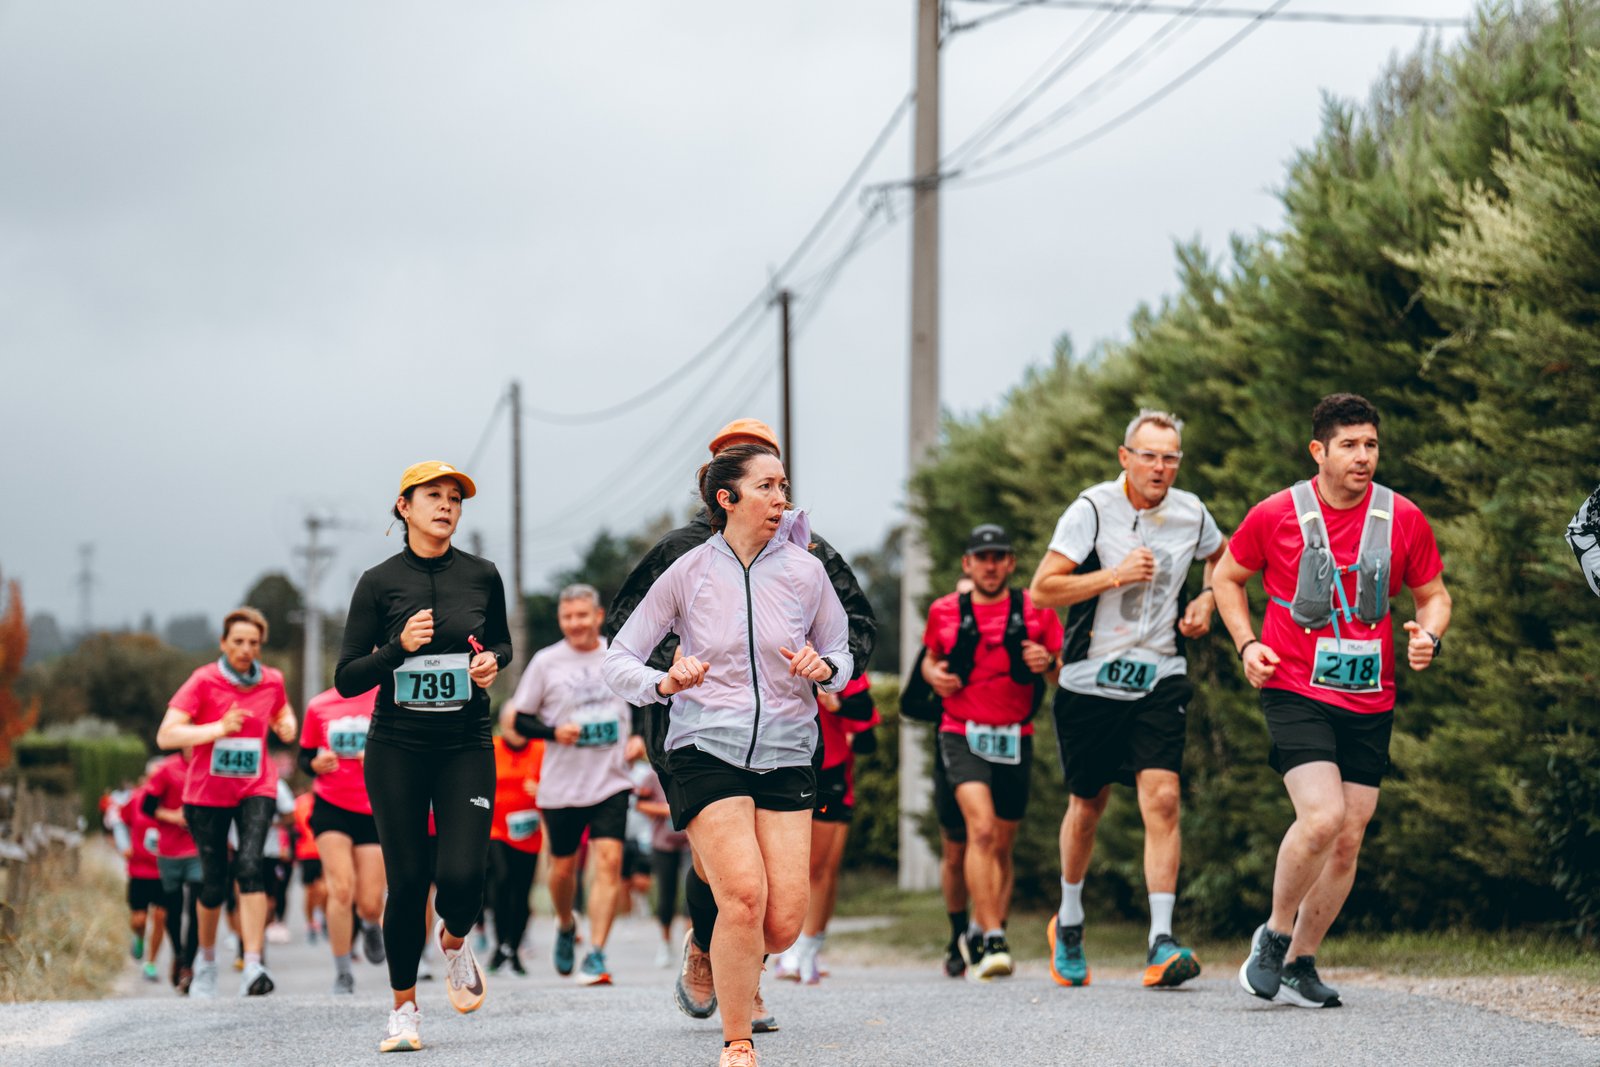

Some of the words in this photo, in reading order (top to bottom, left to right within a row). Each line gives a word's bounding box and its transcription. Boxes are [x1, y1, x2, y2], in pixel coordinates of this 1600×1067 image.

[1108, 659, 1147, 687] 624
[1323, 655, 1374, 682] 218
[408, 671, 456, 700] 739
[578, 722, 614, 740] 449
[978, 734, 1008, 754] 618
[218, 750, 254, 769] 448
